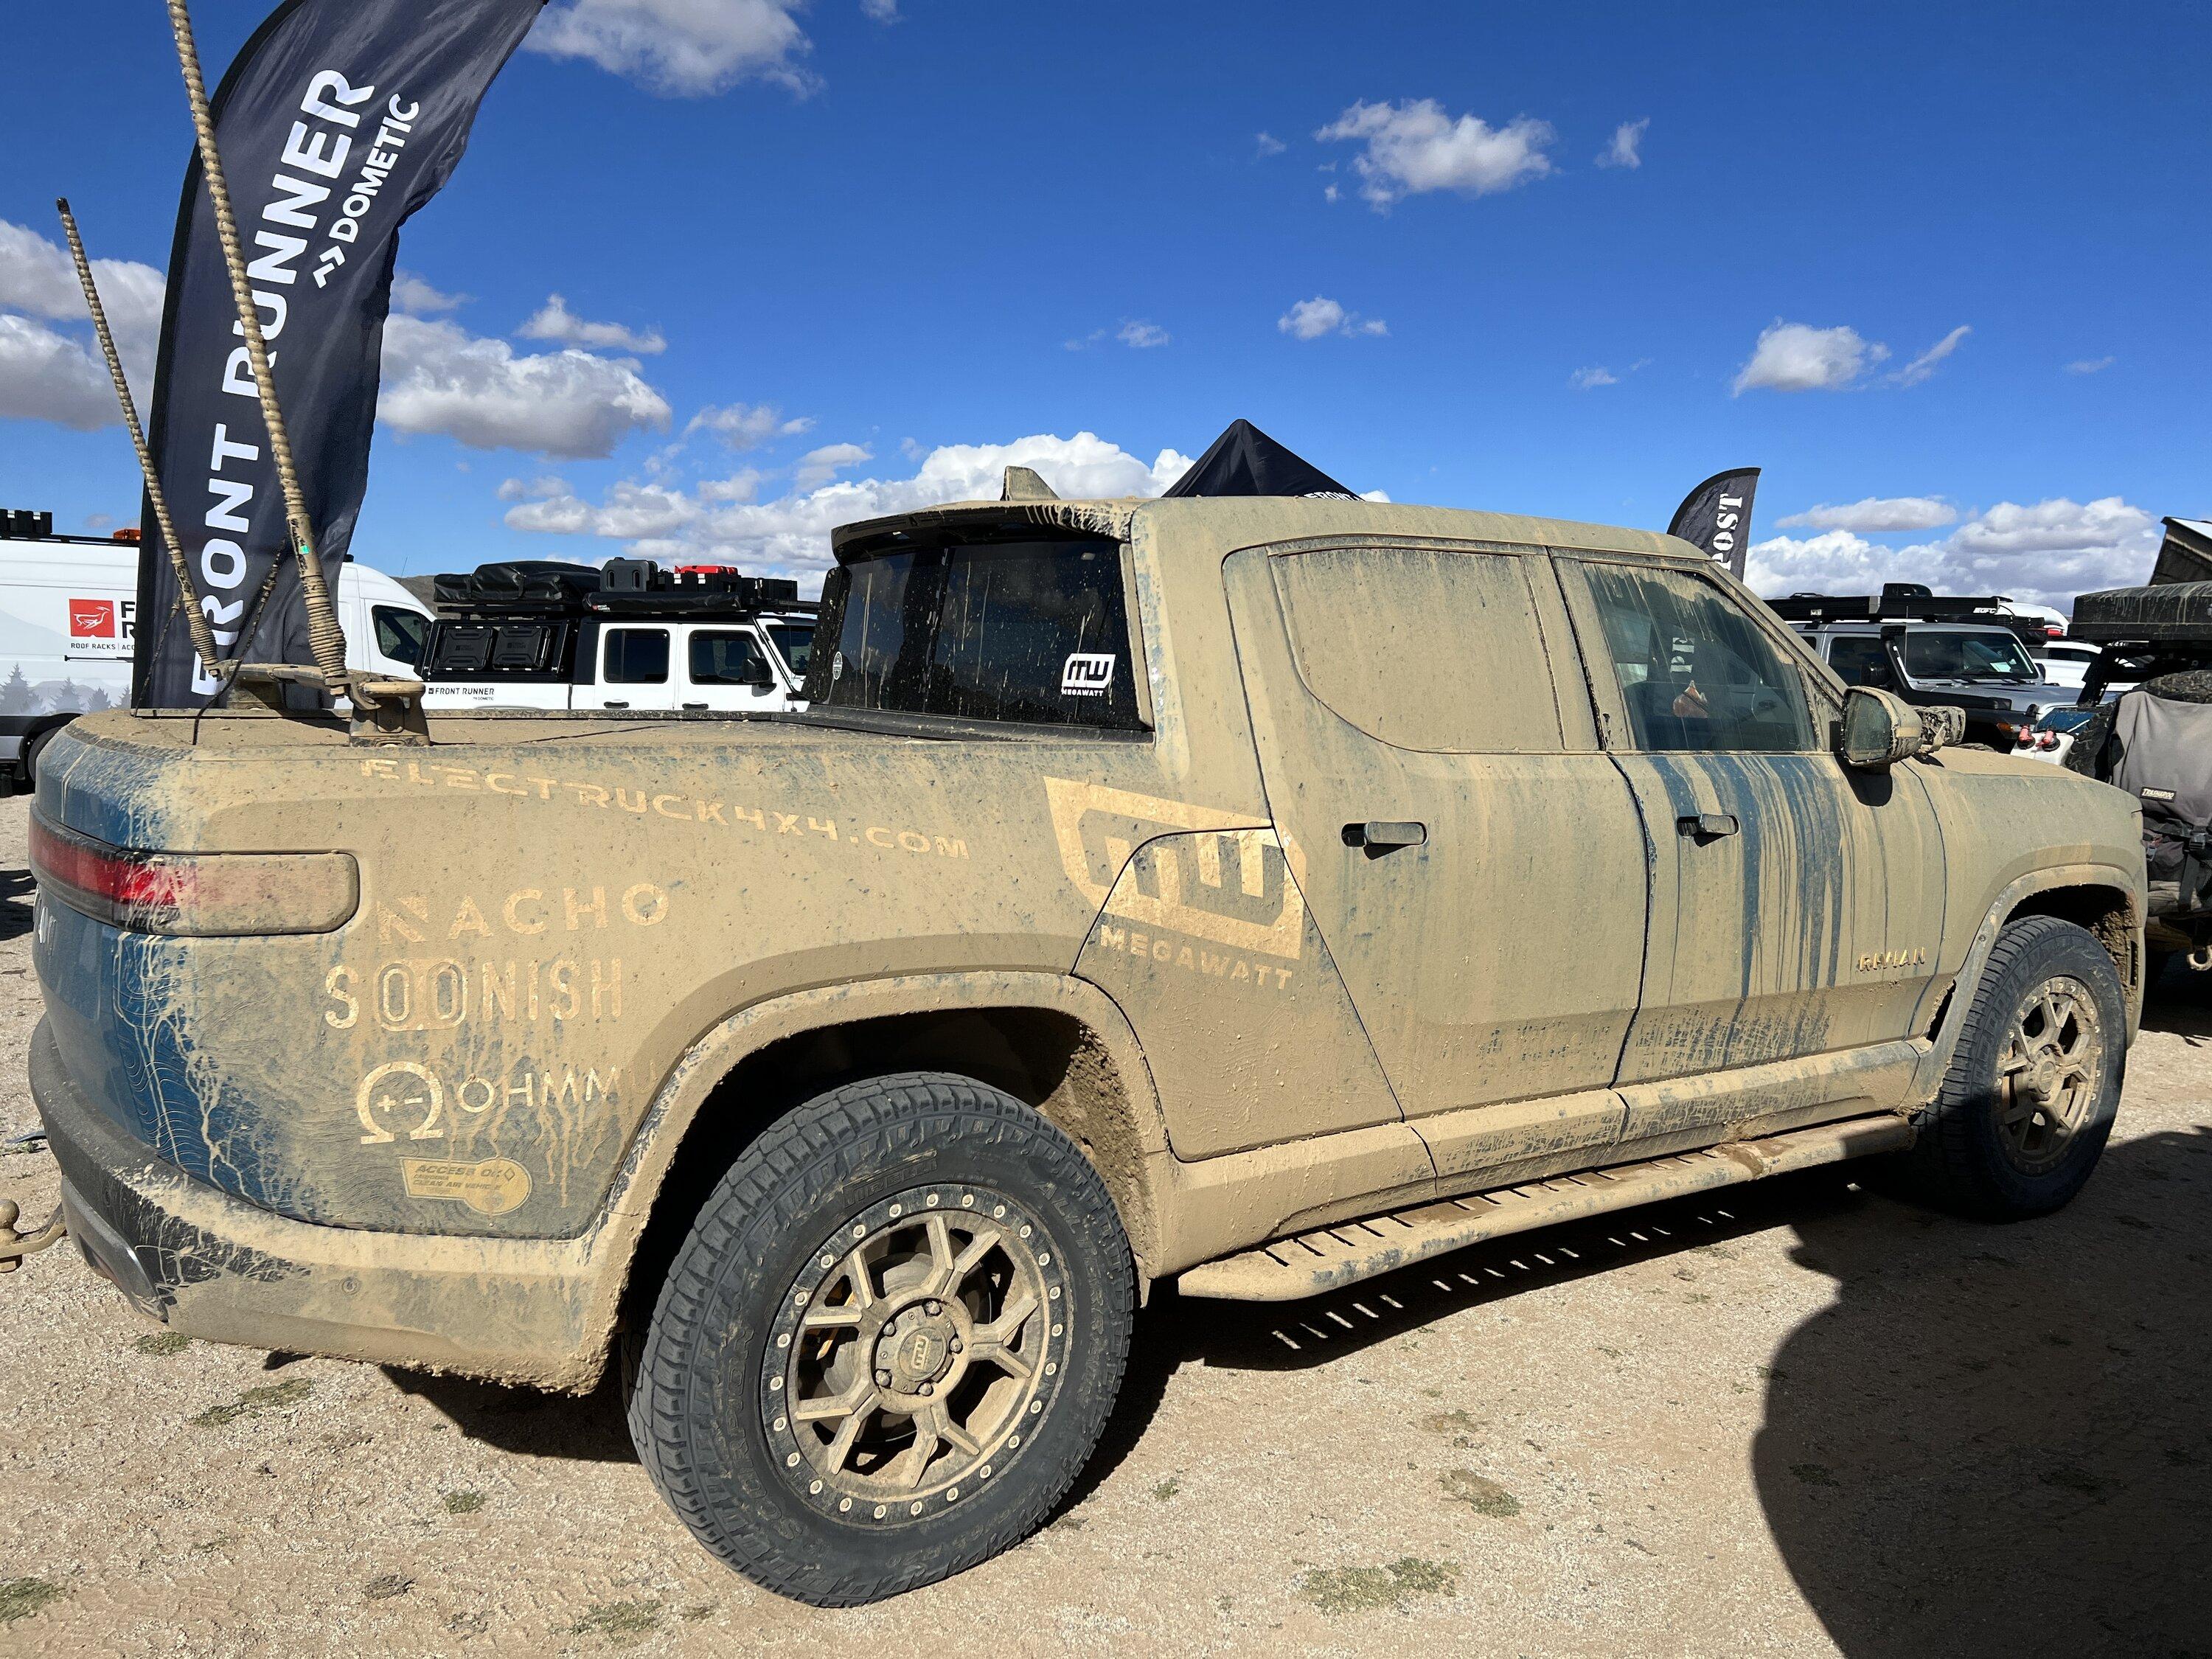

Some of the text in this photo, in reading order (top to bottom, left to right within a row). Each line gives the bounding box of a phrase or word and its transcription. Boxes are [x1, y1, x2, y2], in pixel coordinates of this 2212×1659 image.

[329, 93, 420, 244] DOMETIC
[191, 69, 375, 696] FRONT RUNNER
[462, 687, 494, 695] RUNNER
[1061, 687, 1104, 697] MEGAWATT
[376, 883, 669, 945] NACHO
[1101, 924, 1293, 990] MEGAWATT
[324, 959, 622, 1032] SOONISH
